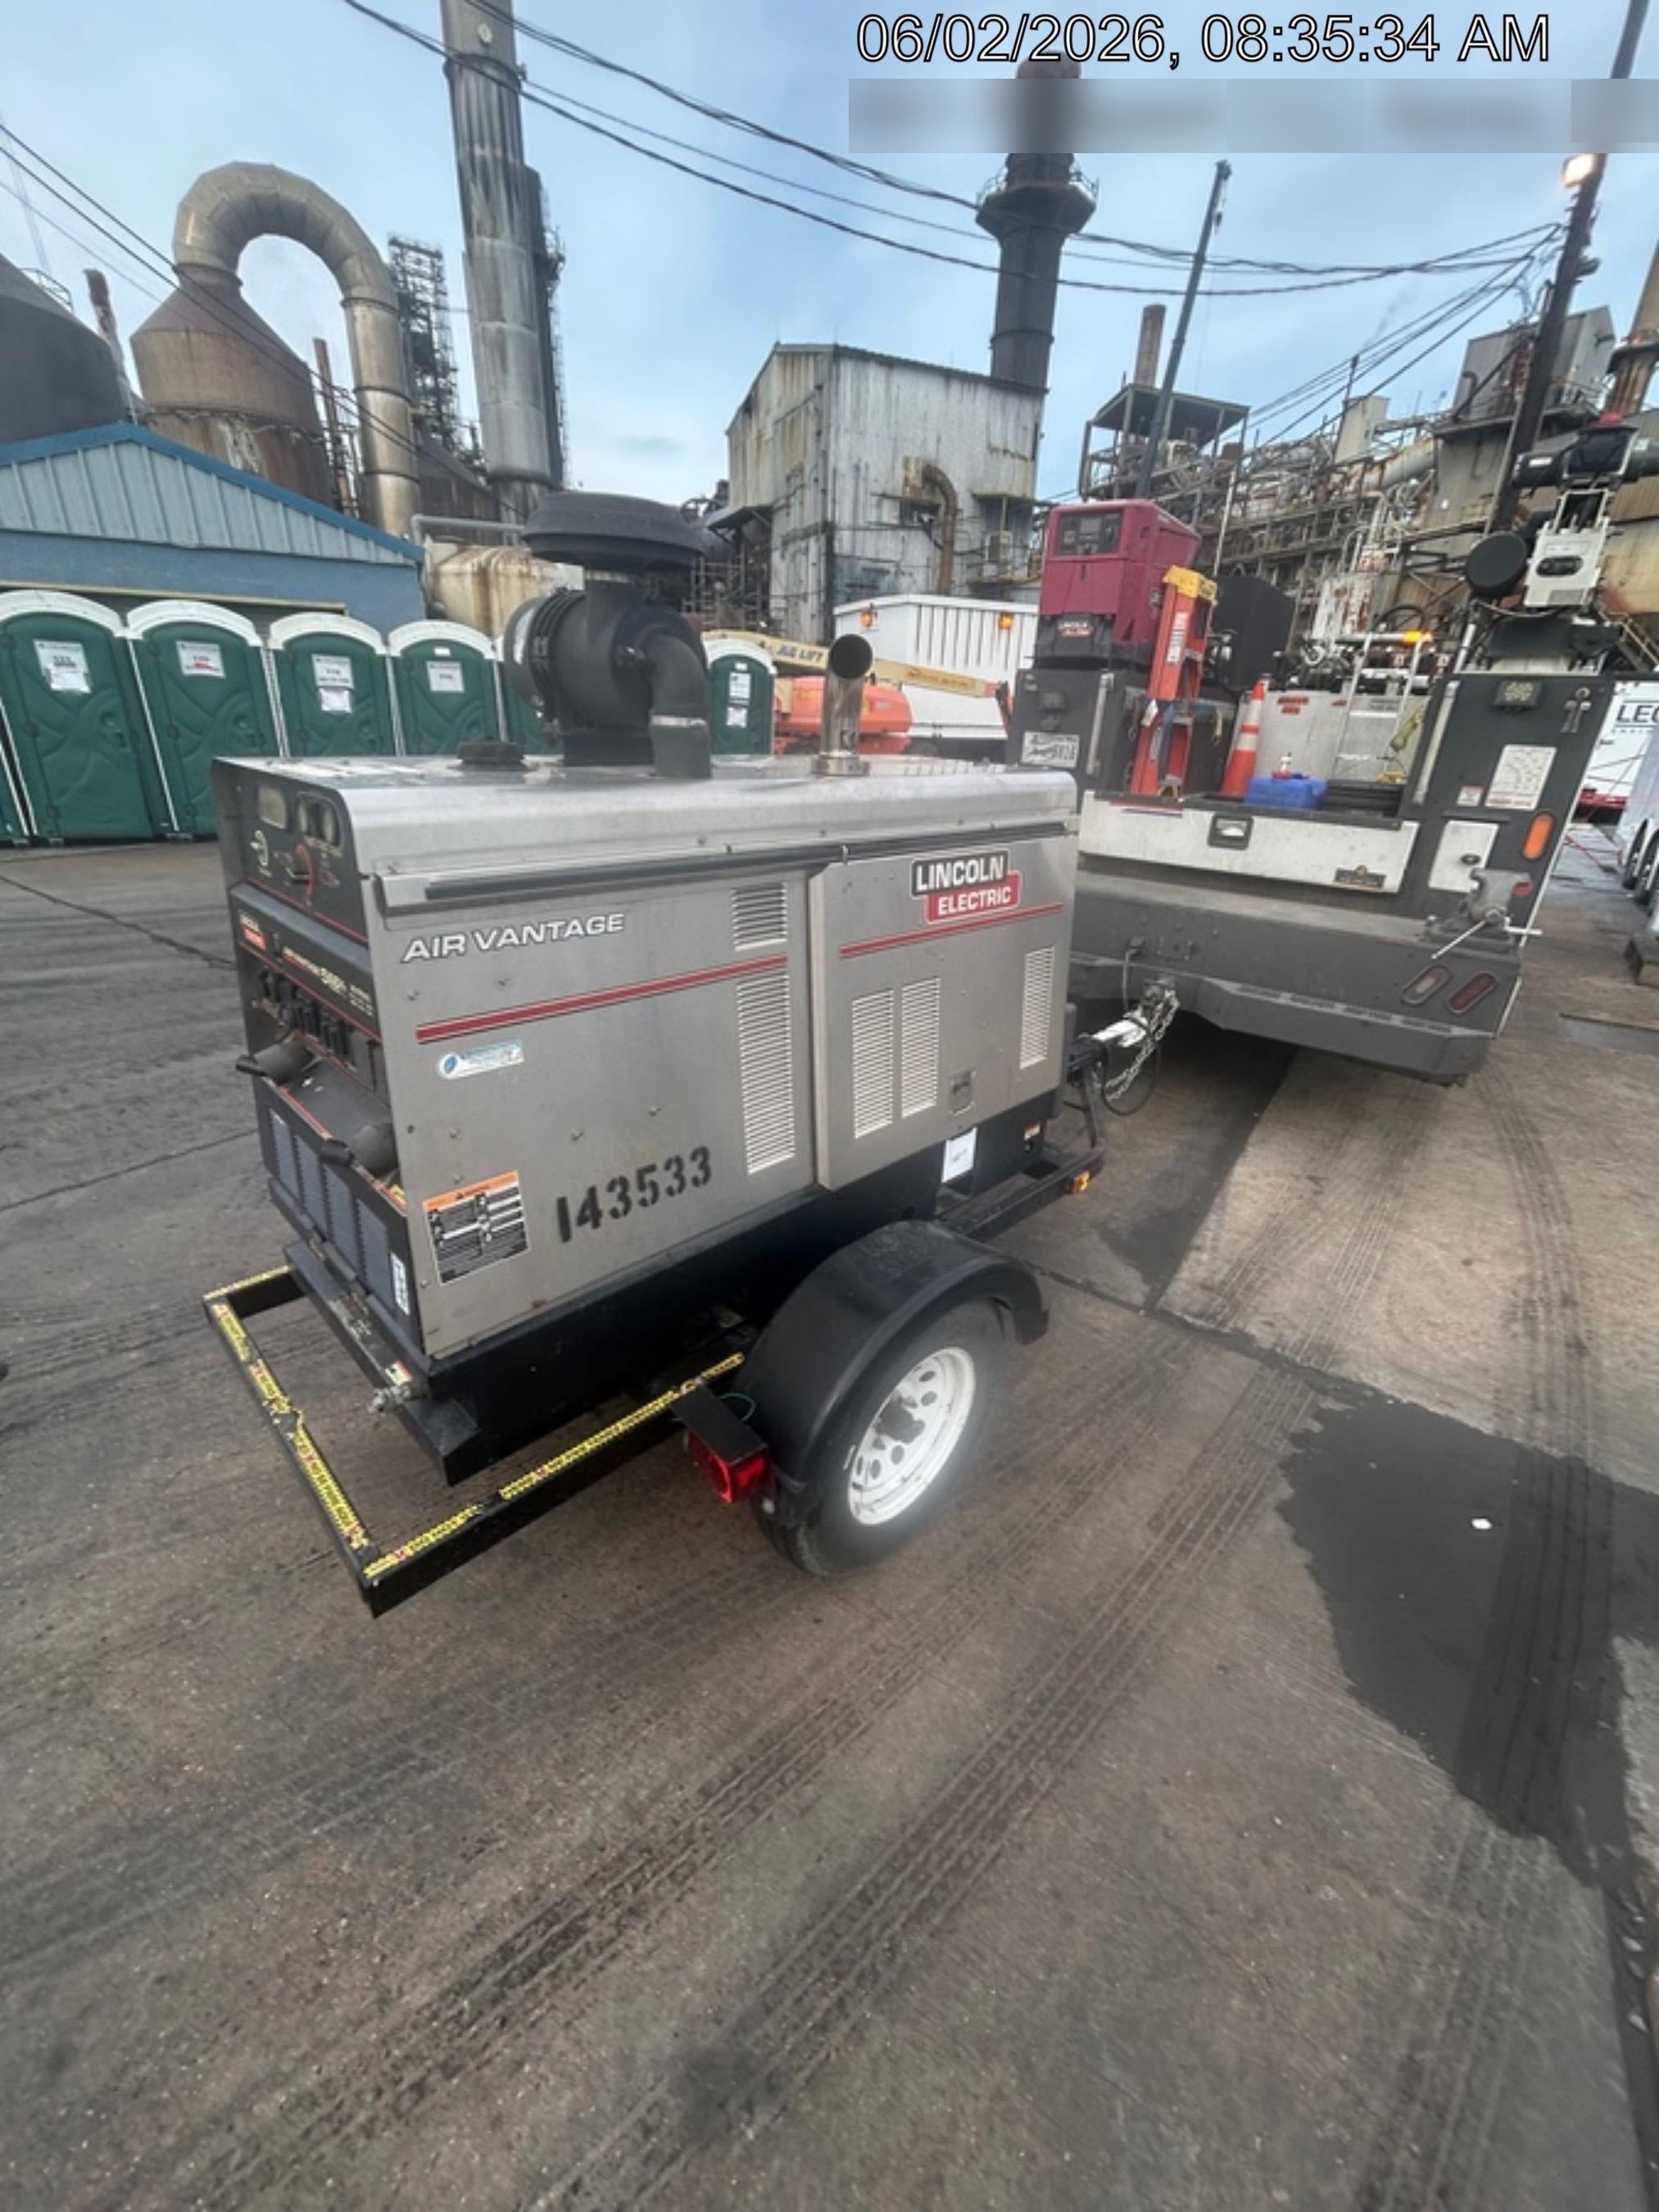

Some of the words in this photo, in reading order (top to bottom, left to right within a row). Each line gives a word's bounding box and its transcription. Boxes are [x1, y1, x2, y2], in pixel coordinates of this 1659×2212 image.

[915, 854, 1004, 892] LINCOLN
[937, 886, 1012, 916] ELECTRIC
[401, 935, 466, 963] AIR
[473, 912, 626, 951] VANTAGE
[556, 1145, 712, 1243] 143533
